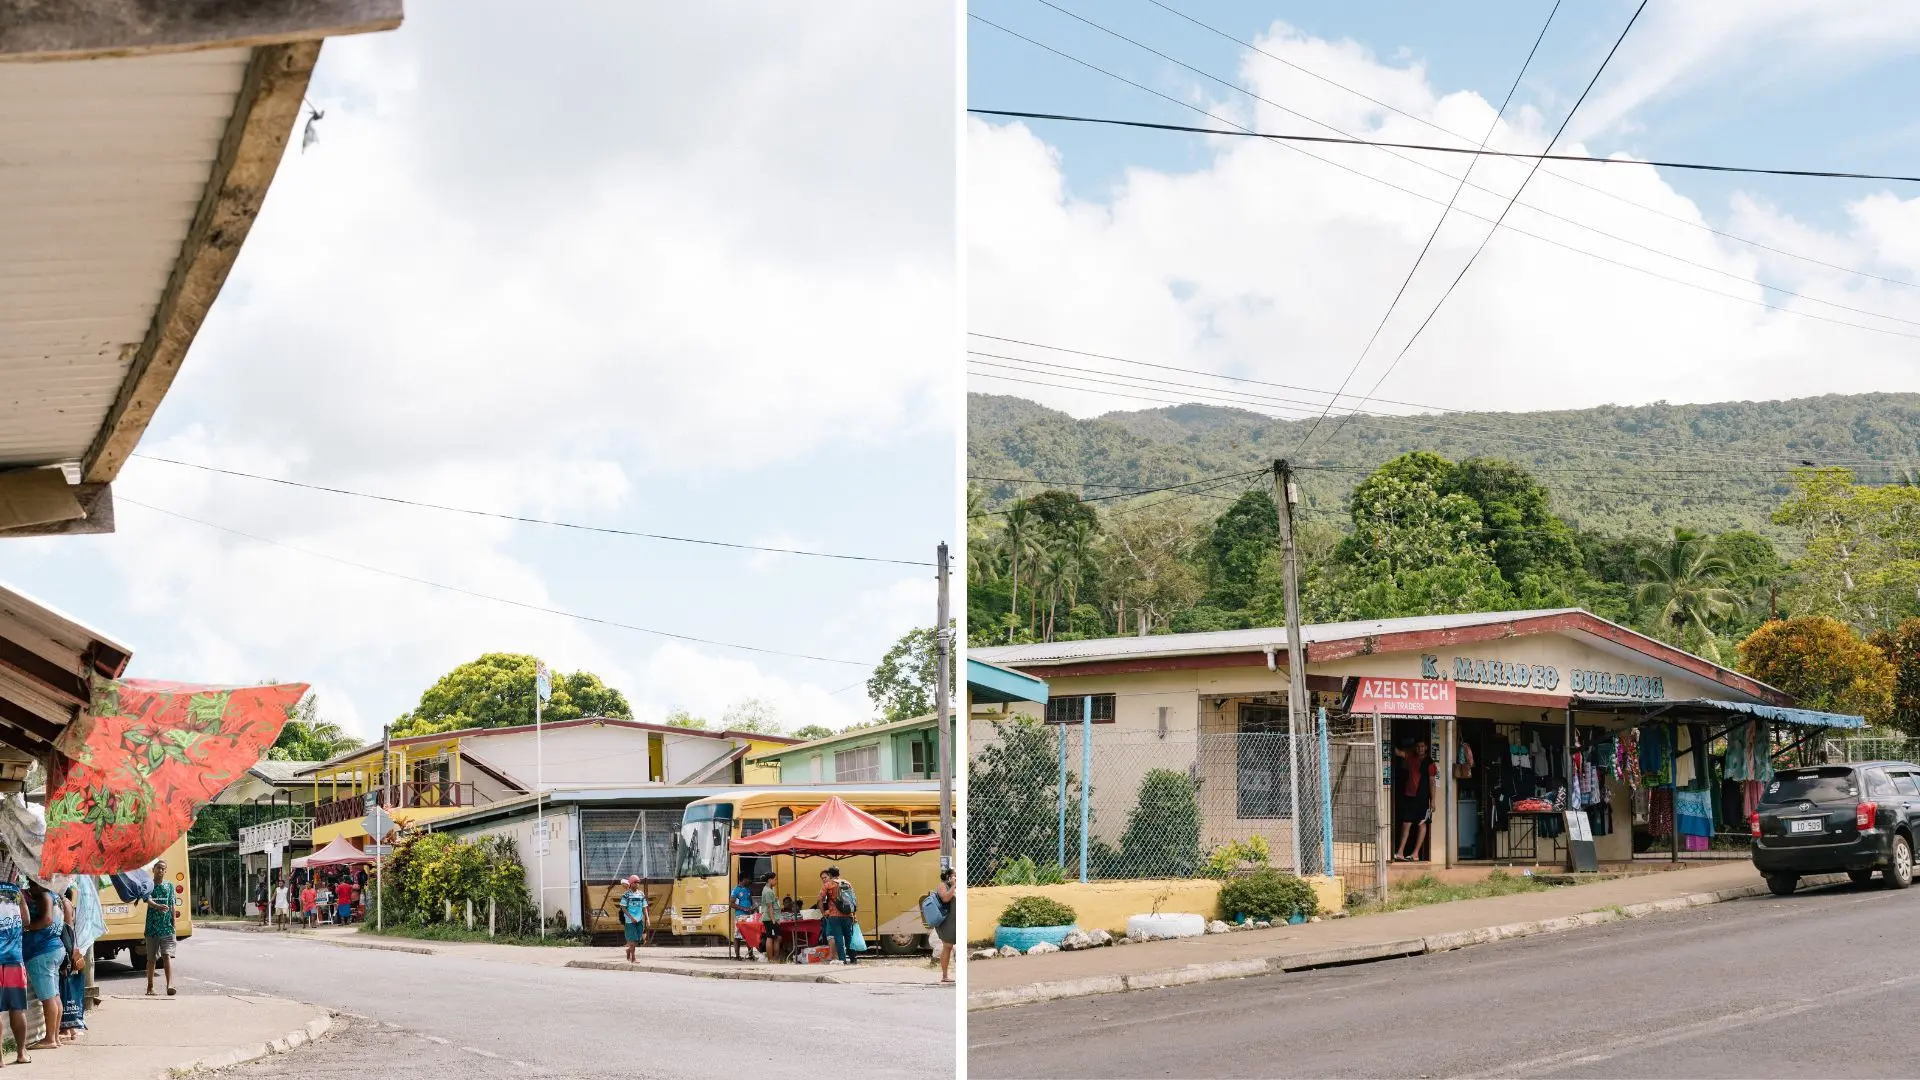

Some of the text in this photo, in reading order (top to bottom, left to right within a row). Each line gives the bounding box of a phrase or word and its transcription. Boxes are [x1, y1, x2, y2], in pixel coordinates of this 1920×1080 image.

[1420, 654, 1664, 699] K. MAHADEO BUILDING
[1362, 680, 1449, 701] AZELS TECH
[1384, 701, 1425, 711] FIJI TRADERS
